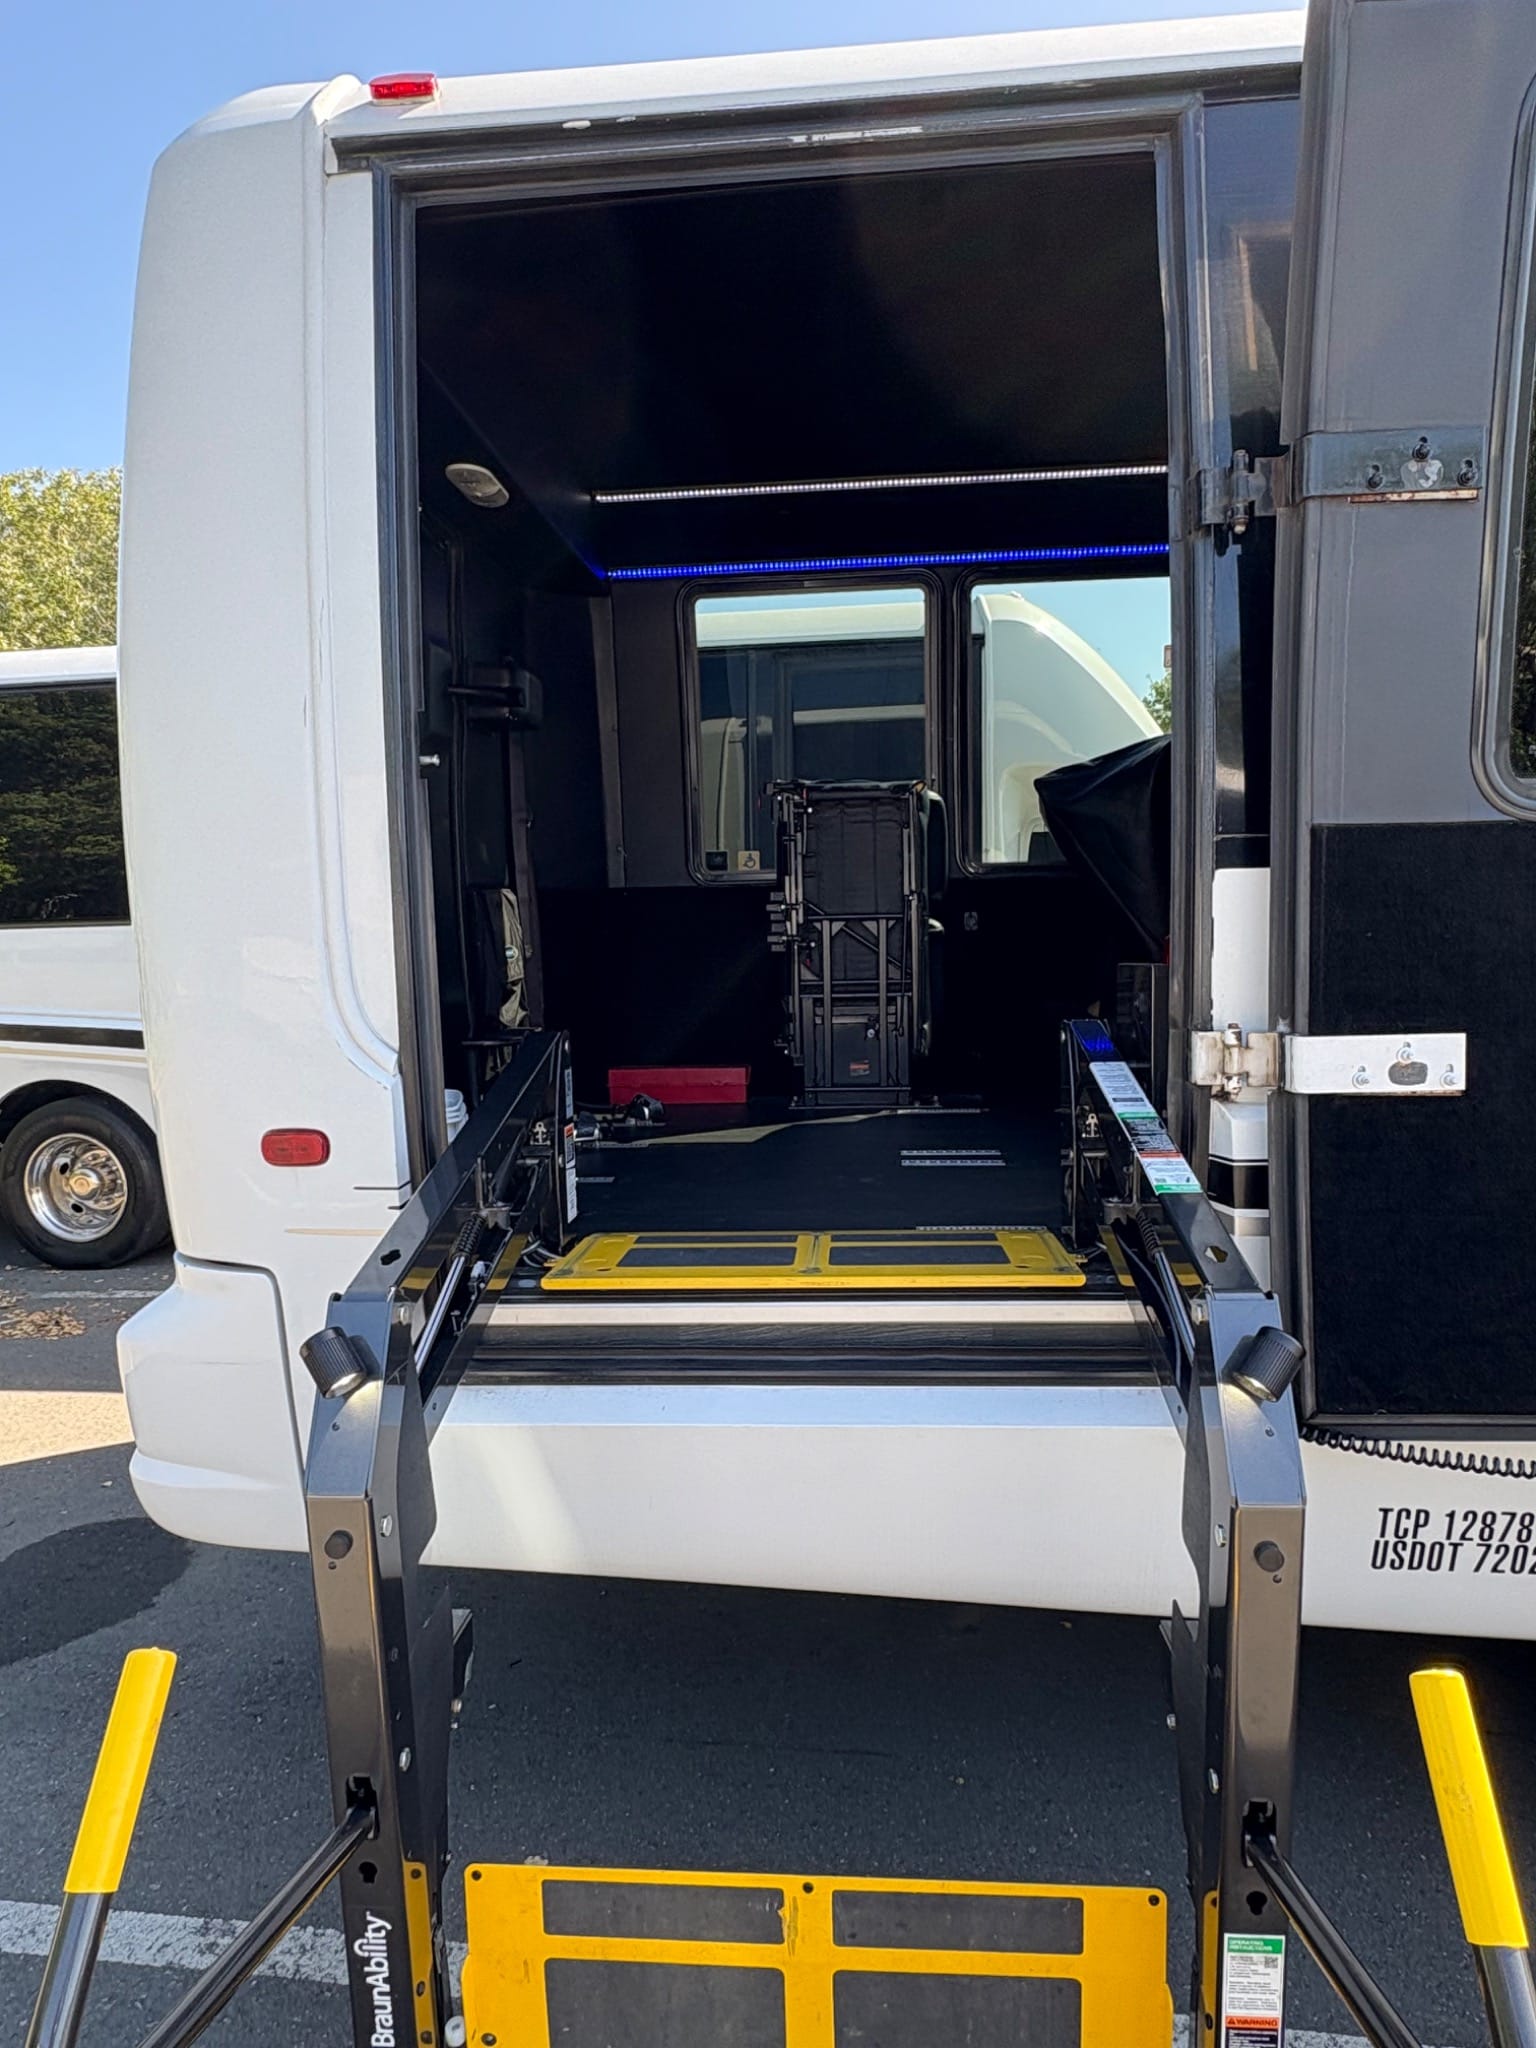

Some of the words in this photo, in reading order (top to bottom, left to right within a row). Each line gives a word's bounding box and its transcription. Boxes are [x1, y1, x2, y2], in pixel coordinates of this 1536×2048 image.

[1378, 1507, 1431, 1540] TCP
[1444, 1509, 1536, 1543] 12878
[1370, 1540, 1464, 1572] USDOT
[353, 1912, 395, 2048] BraunAbility
